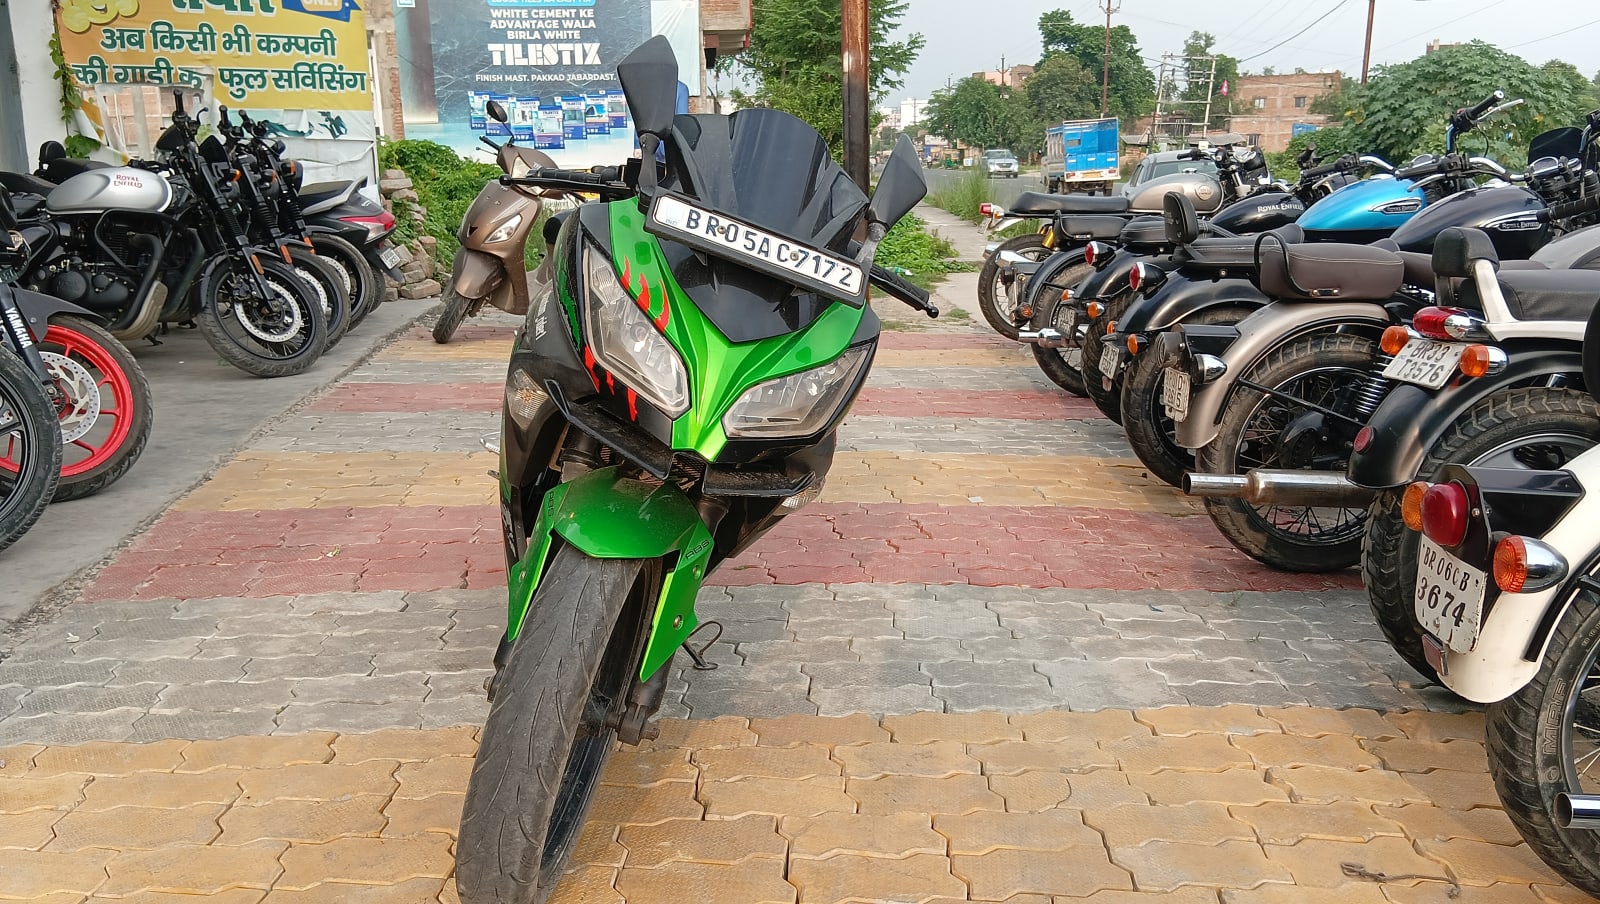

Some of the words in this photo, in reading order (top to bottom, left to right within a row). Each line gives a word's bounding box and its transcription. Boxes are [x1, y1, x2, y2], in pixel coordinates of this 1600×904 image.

[490, 9, 529, 18] WHITE
[531, 9, 577, 18] CEMENT
[579, 9, 595, 18] KE
[490, 19, 560, 29] ADVANTAGE
[562, 19, 597, 29] WALA
[100, 28, 146, 49] अब
[150, 20, 217, 52] किसी
[222, 24, 251, 52] भी
[255, 28, 337, 56] कम्पनी
[507, 30, 541, 40] BIRLA
[543, 30, 581, 39] WHITE
[487, 43, 602, 66] TILESTIX
[71, 55, 109, 85] की
[218, 67, 268, 99] फुल
[271, 61, 367, 91] सर्विसिंग
[475, 74, 503, 82] FINISH
[505, 74, 530, 82] MAST.
[567, 73, 617, 81] JABARDAST.
[116, 174, 139, 182] ROYAL
[1257, 203, 1280, 213] ROYAL
[5, 306, 33, 349] YAMAHA
[685, 539, 710, 560] ABS
[1417, 577, 1467, 628] 3674
[1542, 677, 1567, 755] MRF
